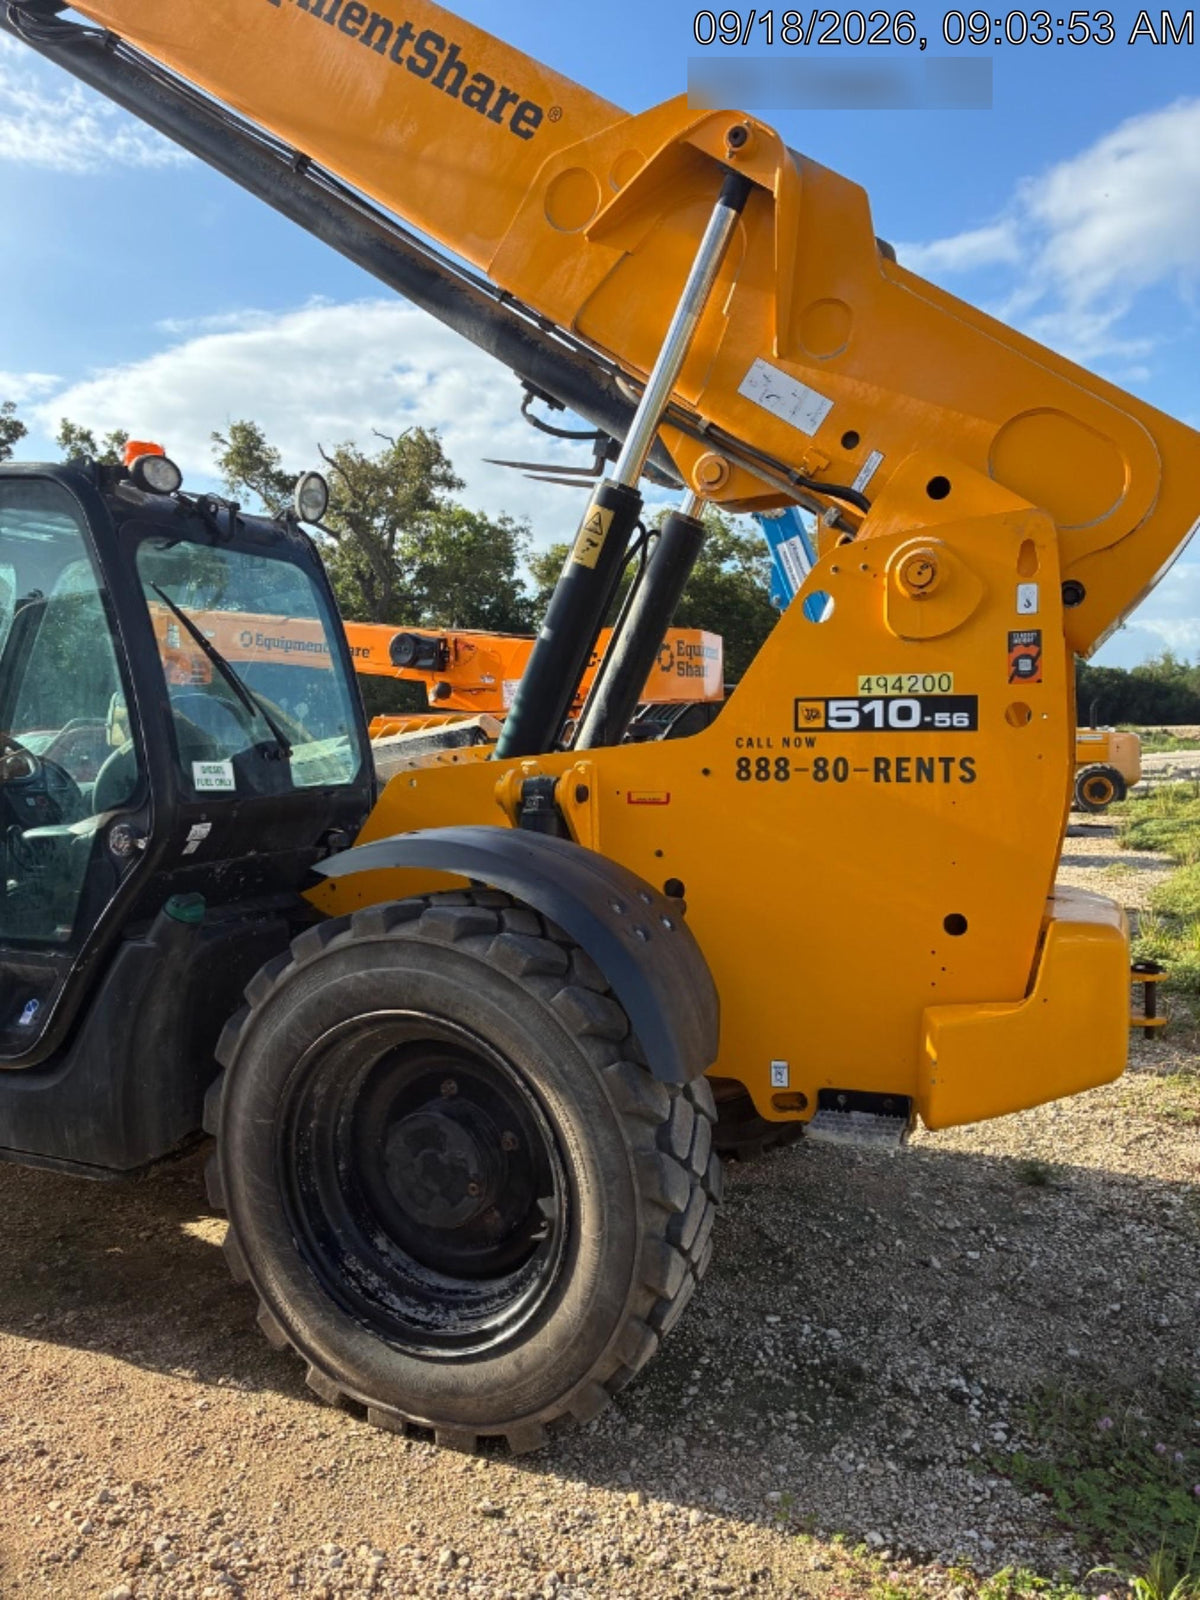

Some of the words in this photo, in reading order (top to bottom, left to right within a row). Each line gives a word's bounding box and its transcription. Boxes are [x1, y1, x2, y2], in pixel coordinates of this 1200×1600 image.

[860, 673, 952, 694] 494200
[827, 698, 970, 729] 510-56
[736, 737, 773, 749] CALL
[782, 737, 817, 749] NOW
[736, 756, 977, 784] 888-80-RENTS
[197, 777, 214, 787] FUEL
[215, 777, 232, 787] ONLY
